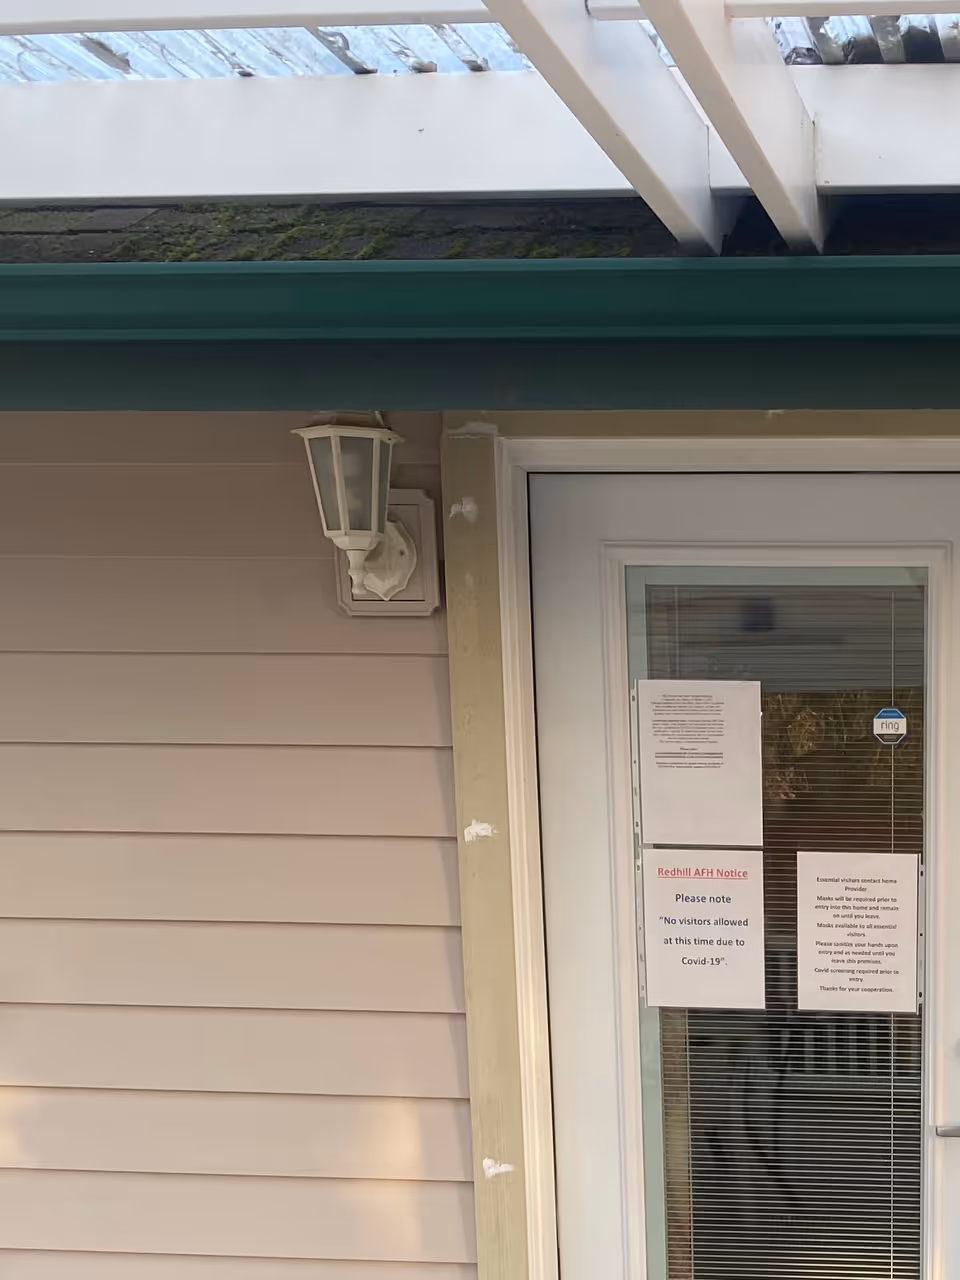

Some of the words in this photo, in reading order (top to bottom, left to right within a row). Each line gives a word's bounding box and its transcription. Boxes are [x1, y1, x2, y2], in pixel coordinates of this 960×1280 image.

[881, 720, 899, 732] ring
[658, 868, 691, 878] Redhill
[694, 868, 713, 878] AFH
[716, 869, 748, 878] Notice
[675, 894, 706, 903] Please
[679, 917, 711, 926] visitors
[713, 918, 748, 926] allowed
[694, 937, 714, 946] time
[716, 938, 733, 946] due
